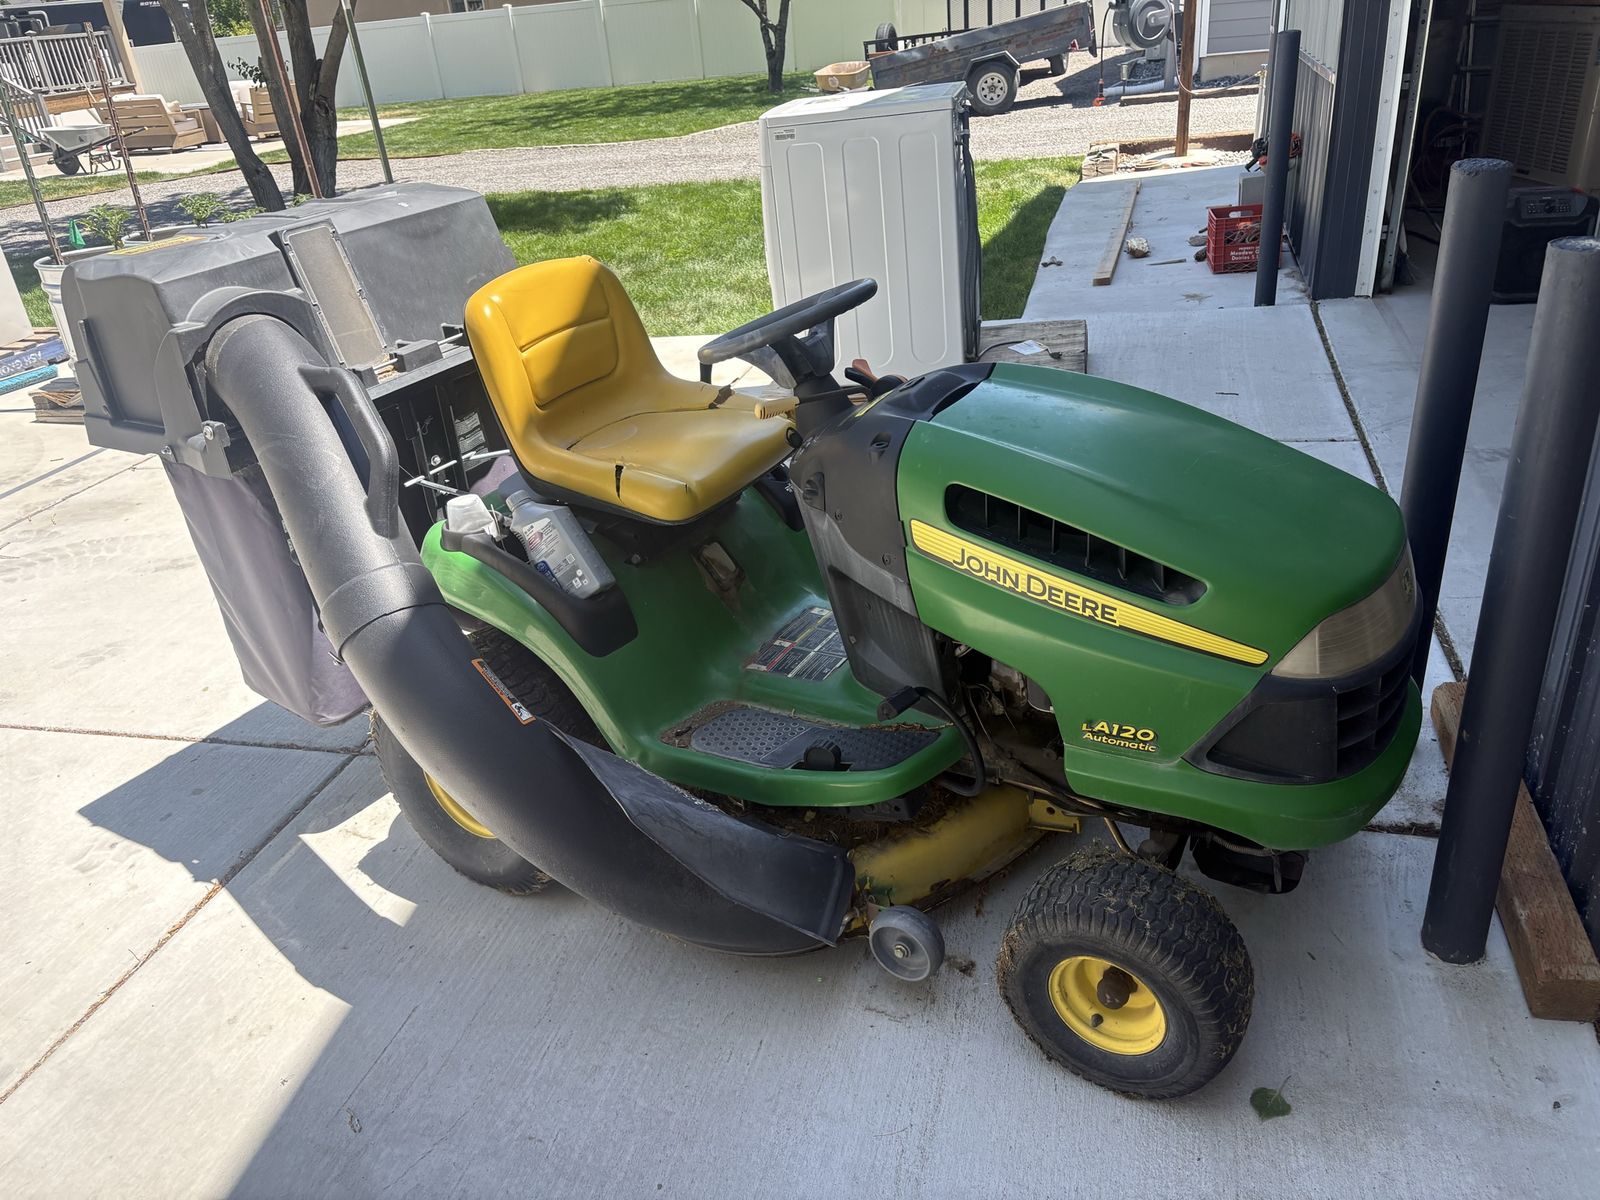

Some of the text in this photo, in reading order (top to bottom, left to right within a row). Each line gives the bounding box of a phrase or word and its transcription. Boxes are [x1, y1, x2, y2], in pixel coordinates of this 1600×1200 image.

[953, 548, 1118, 624] JOHN DEERE
[1082, 721, 1155, 741] LA120
[1083, 732, 1157, 752] Automatic
